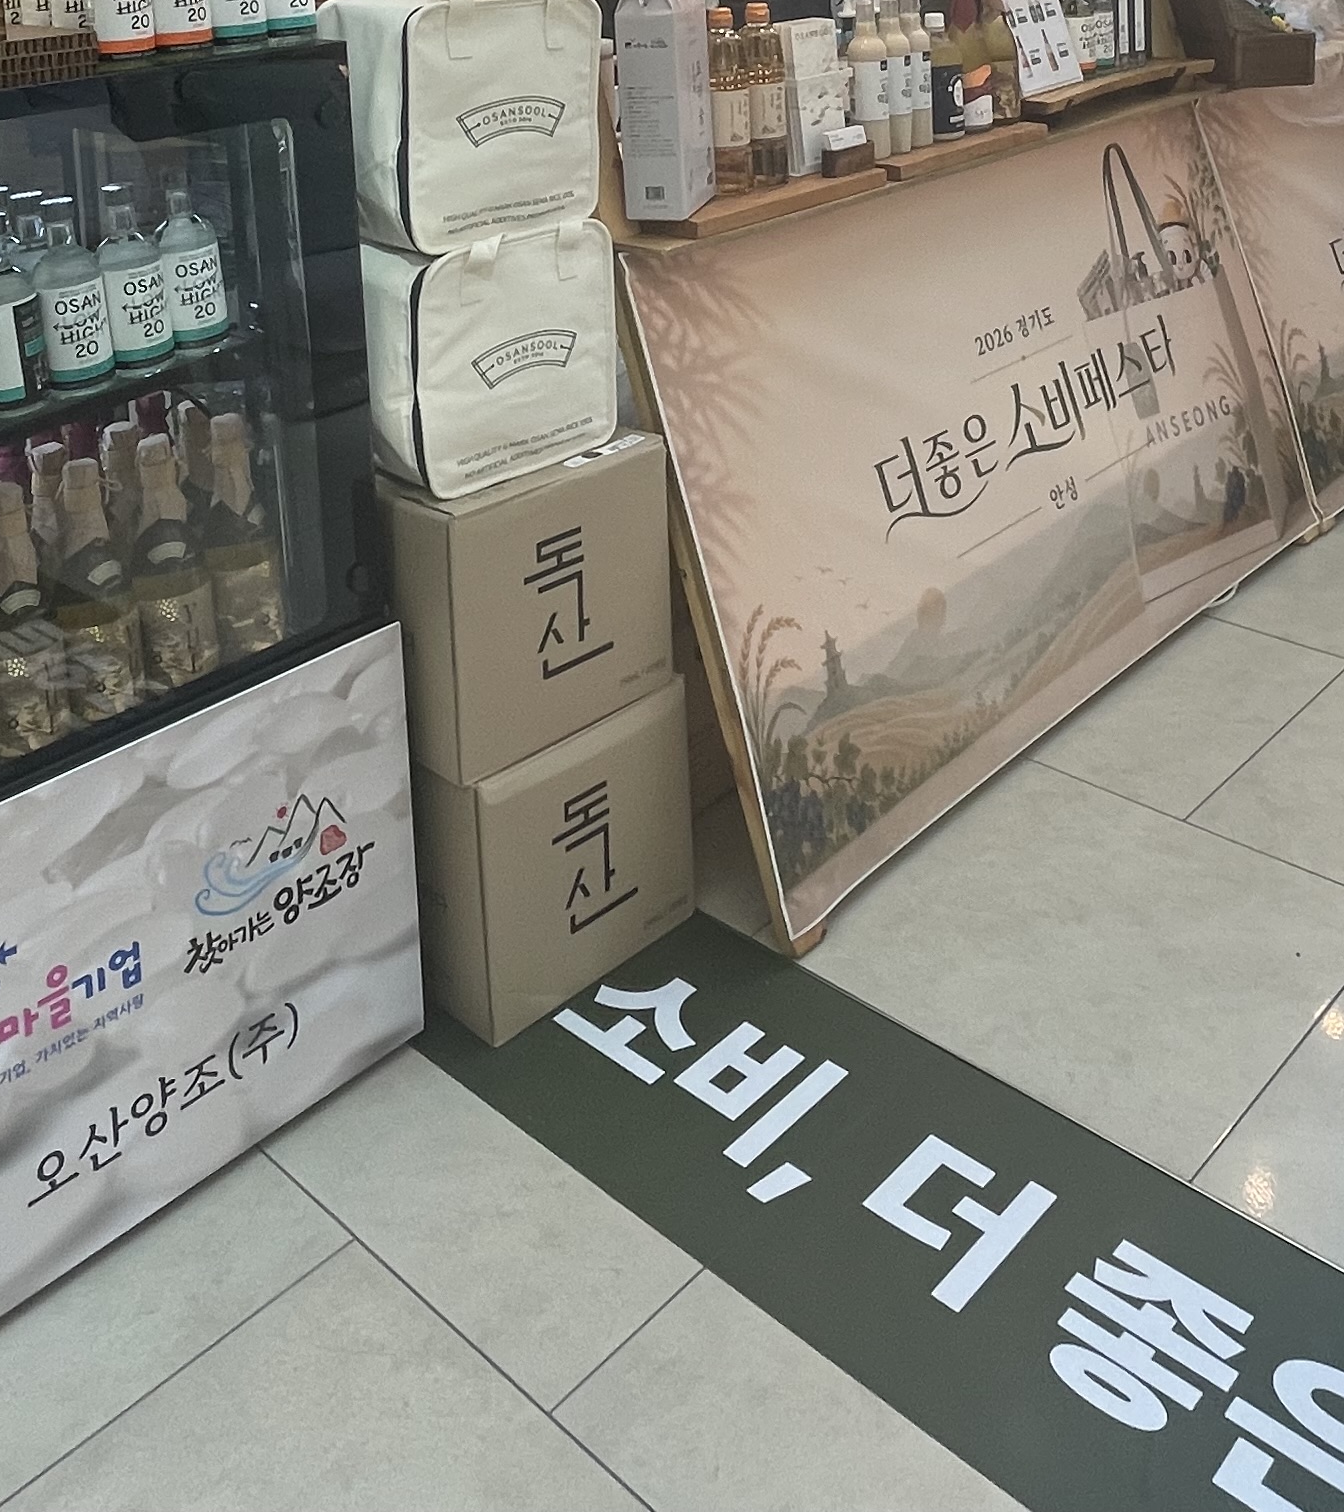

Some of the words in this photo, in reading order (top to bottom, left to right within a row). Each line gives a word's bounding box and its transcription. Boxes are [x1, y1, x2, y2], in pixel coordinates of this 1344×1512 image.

[187, 7, 207, 22] 20
[239, 0, 260, 15] 20
[131, 14, 150, 29] 20
[482, 105, 546, 125] OSANSOOL
[175, 257, 217, 278] OSAN
[55, 290, 101, 315] OSAN
[194, 302, 216, 319] 20
[143, 319, 164, 338] 20
[974, 325, 1013, 357] 2026
[1015, 306, 1056, 339] 경기도
[75, 340, 99, 359] 20
[496, 340, 558, 366] OSANSOOL
[1145, 394, 1233, 448] ANSEONG
[1048, 476, 1079, 511] 안성
[184, 909, 275, 976] 찾아가는
[272, 840, 378, 925] 양조장
[35, 1026, 90, 1064] 가치있는
[27, 1002, 301, 1208] 오산양조(주)
[551, 975, 851, 1204] 소비,
[861, 1133, 1058, 1313] 더
